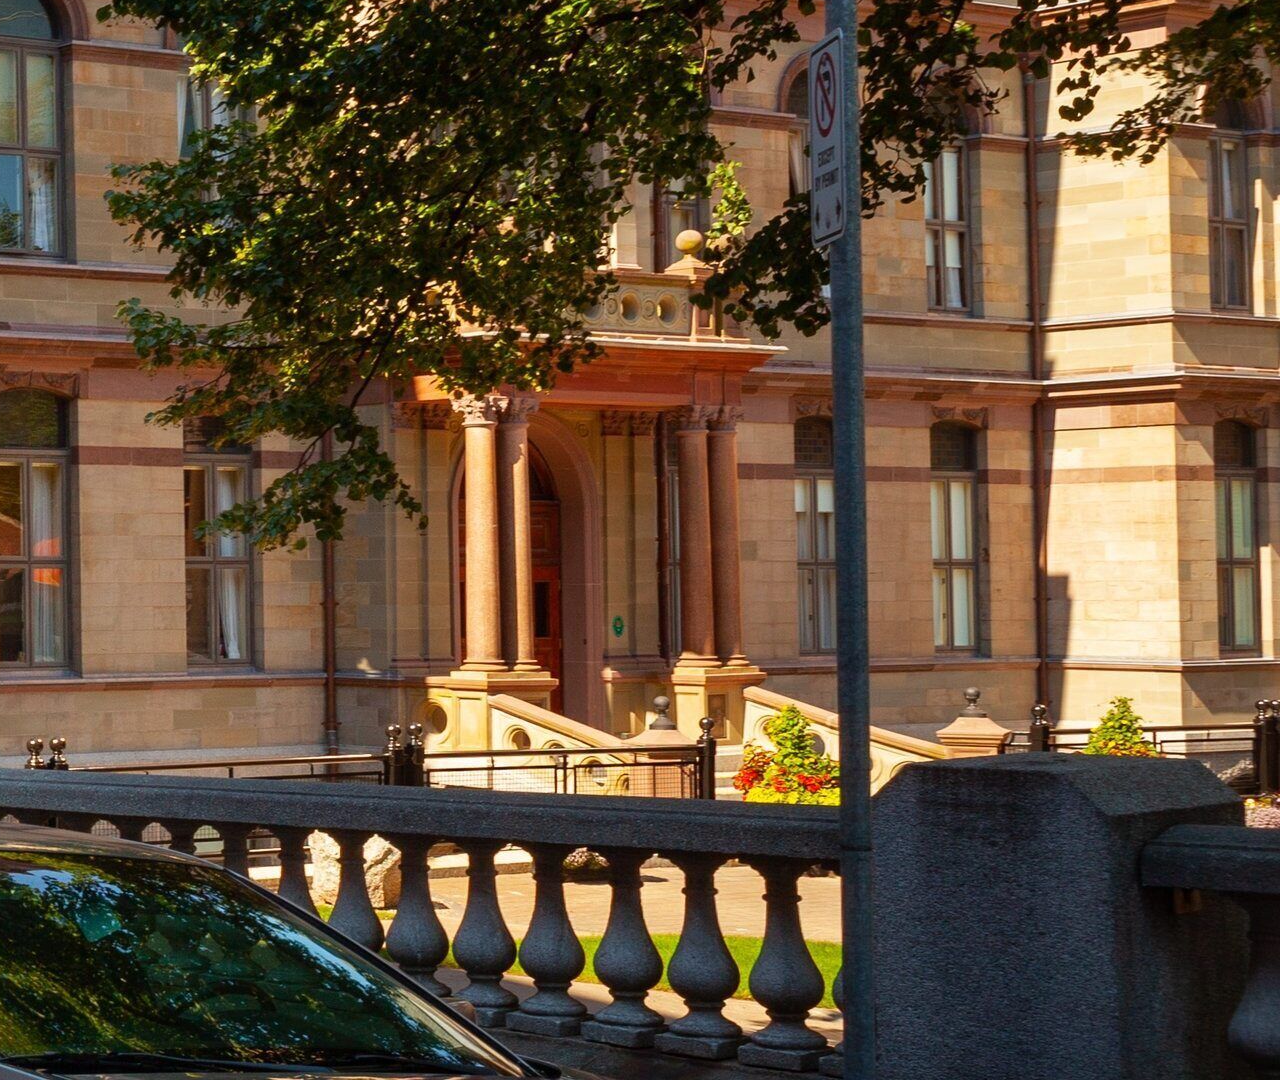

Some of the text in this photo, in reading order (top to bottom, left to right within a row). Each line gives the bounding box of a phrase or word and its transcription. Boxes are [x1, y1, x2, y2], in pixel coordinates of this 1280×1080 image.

[818, 145, 835, 168] EXCEPT
[815, 167, 839, 192] BY PERMIT
